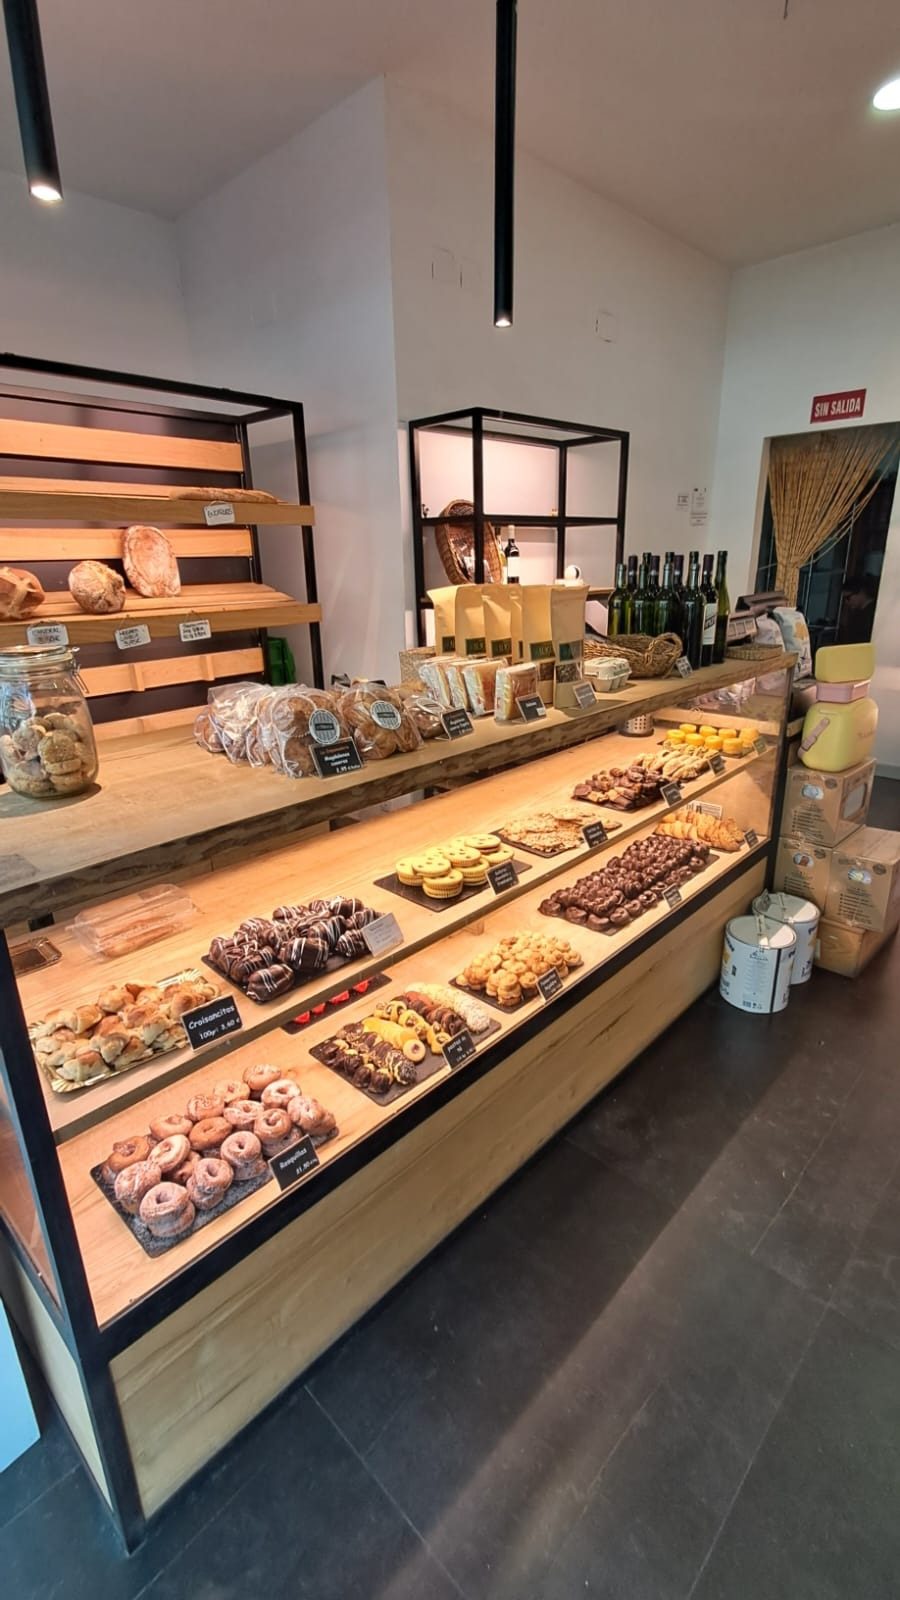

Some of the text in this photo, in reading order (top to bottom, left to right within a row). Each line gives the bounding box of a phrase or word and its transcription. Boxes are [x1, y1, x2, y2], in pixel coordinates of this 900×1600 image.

[814, 397, 861, 417] SIN SALIDA
[188, 1006, 235, 1030] Croisancitos
